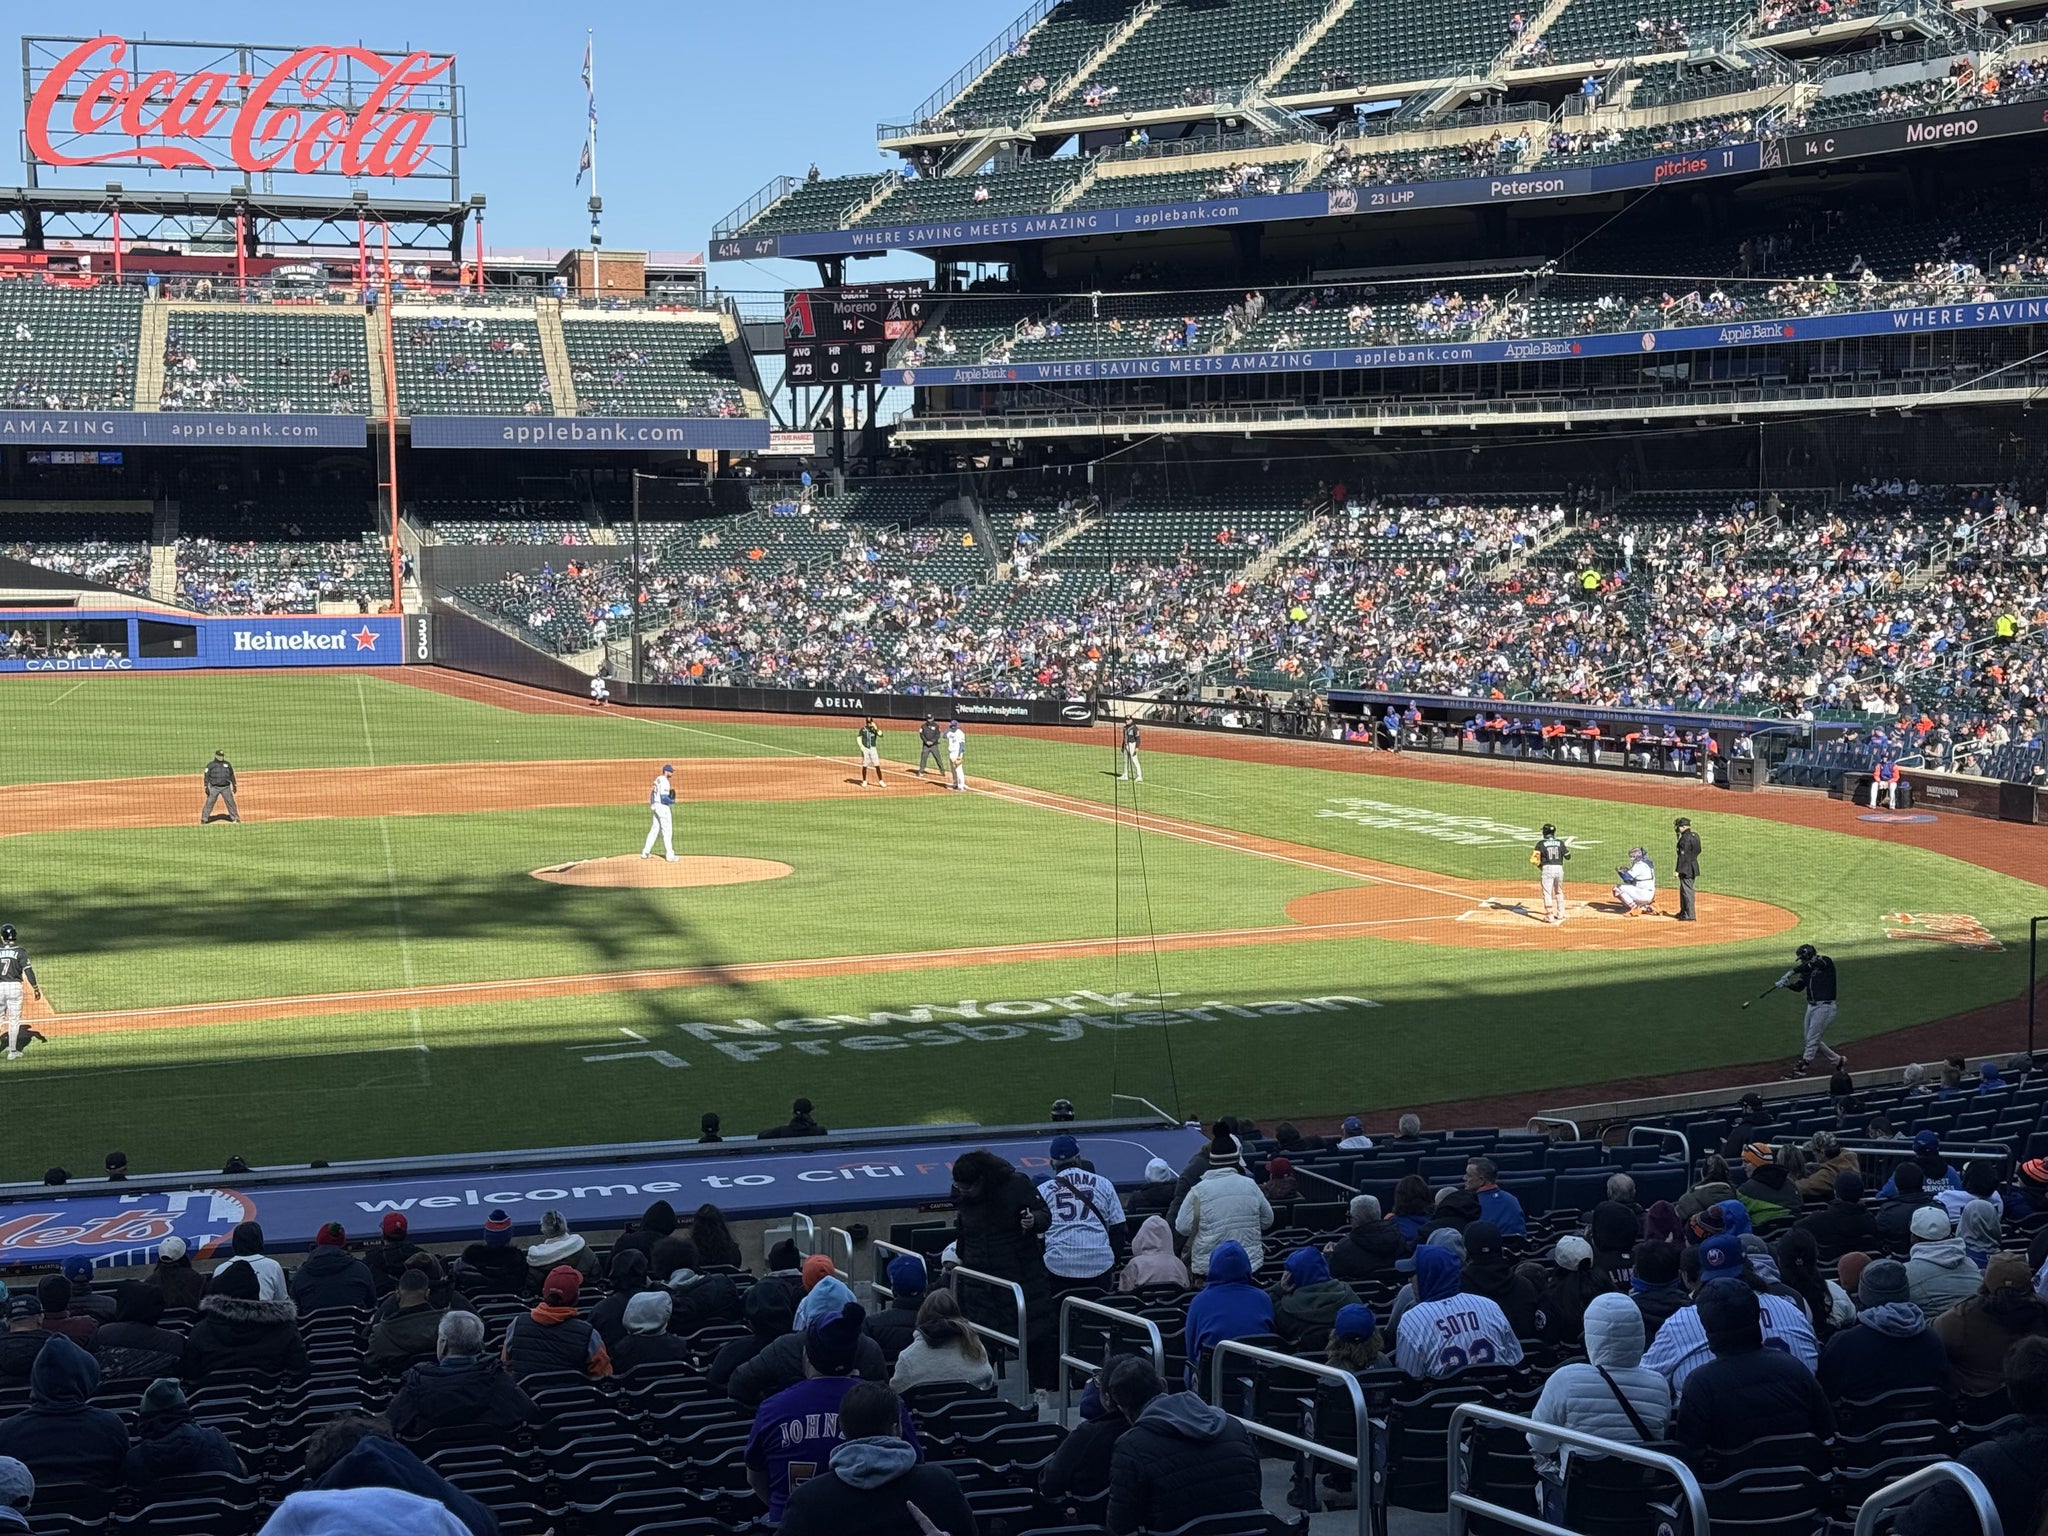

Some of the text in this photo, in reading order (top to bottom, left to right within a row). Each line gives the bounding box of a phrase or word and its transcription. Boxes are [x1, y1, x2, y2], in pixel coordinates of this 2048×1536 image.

[27, 35, 457, 178] Coca-Cola
[1906, 119, 1979, 143] Moreno
[1804, 141, 1818, 156] 14
[1824, 139, 1835, 153] C
[1654, 150, 1734, 182] pitches 11
[1490, 178, 1565, 197] Peterson
[1370, 191, 1415, 206] 23 LHP
[852, 204, 1239, 245] WHERE SAVING MEETS AMAZING applebank.com
[718, 243, 741, 257] 4:14
[886, 287, 906, 301] Top
[833, 302, 877, 314] Moreno
[842, 319, 865, 331] 14 C
[1893, 309, 1964, 328] WHERE
[1719, 324, 1783, 343] Apple Bank
[792, 347, 811, 357] AVG
[828, 346, 841, 356] HR
[861, 344, 876, 354] RBI
[1504, 341, 1571, 358] Apple Bank
[792, 363, 813, 376] .273
[831, 362, 839, 375] 0
[864, 361, 873, 373] 2
[1038, 347, 1473, 377] WHERE SAVING MEETS AMAZING applebank.com
[981, 368, 1007, 379] Bank
[3, 420, 319, 438] AMAZING applebank.com
[503, 422, 684, 444] applebank.com
[233, 630, 347, 651] Heineken
[417, 618, 429, 660] 330
[26, 658, 133, 671] CADILLAC
[825, 697, 863, 709] DELTA
[1442, 700, 1469, 709] WHERE
[1472, 701, 1504, 711] SAVING
[1505, 704, 1534, 714] MEETS
[1535, 706, 1575, 717] AMAZING
[0, 958, 11, 976] 7
[711, 995, 1385, 1062] Presbyterian
[354, 1181, 682, 1213] welcome
[700, 1173, 776, 1189] to
[797, 1161, 905, 1183] citi
[1055, 1188, 1095, 1221] 57
[1436, 1311, 1480, 1339] SOTO
[780, 1412, 847, 1449] JOHN
